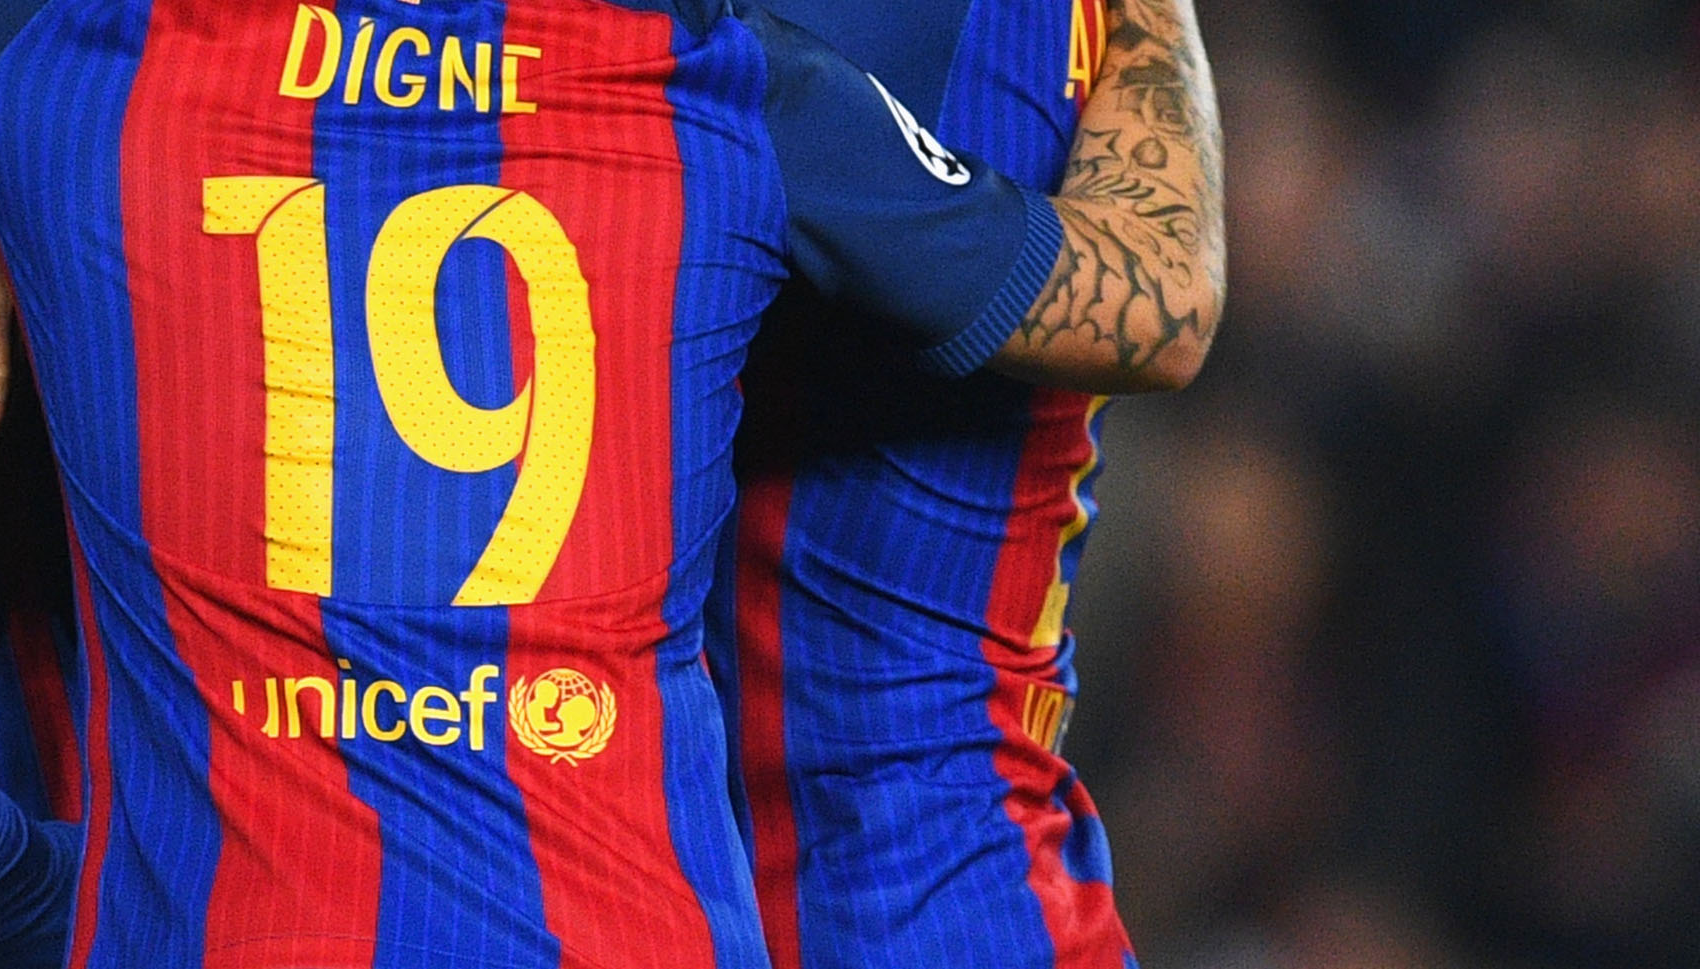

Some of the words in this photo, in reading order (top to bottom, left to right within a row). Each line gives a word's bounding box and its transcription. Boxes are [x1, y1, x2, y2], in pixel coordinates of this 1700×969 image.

[278, 4, 542, 114] DIGNE
[202, 175, 597, 607] 19
[231, 664, 499, 751] unicef
